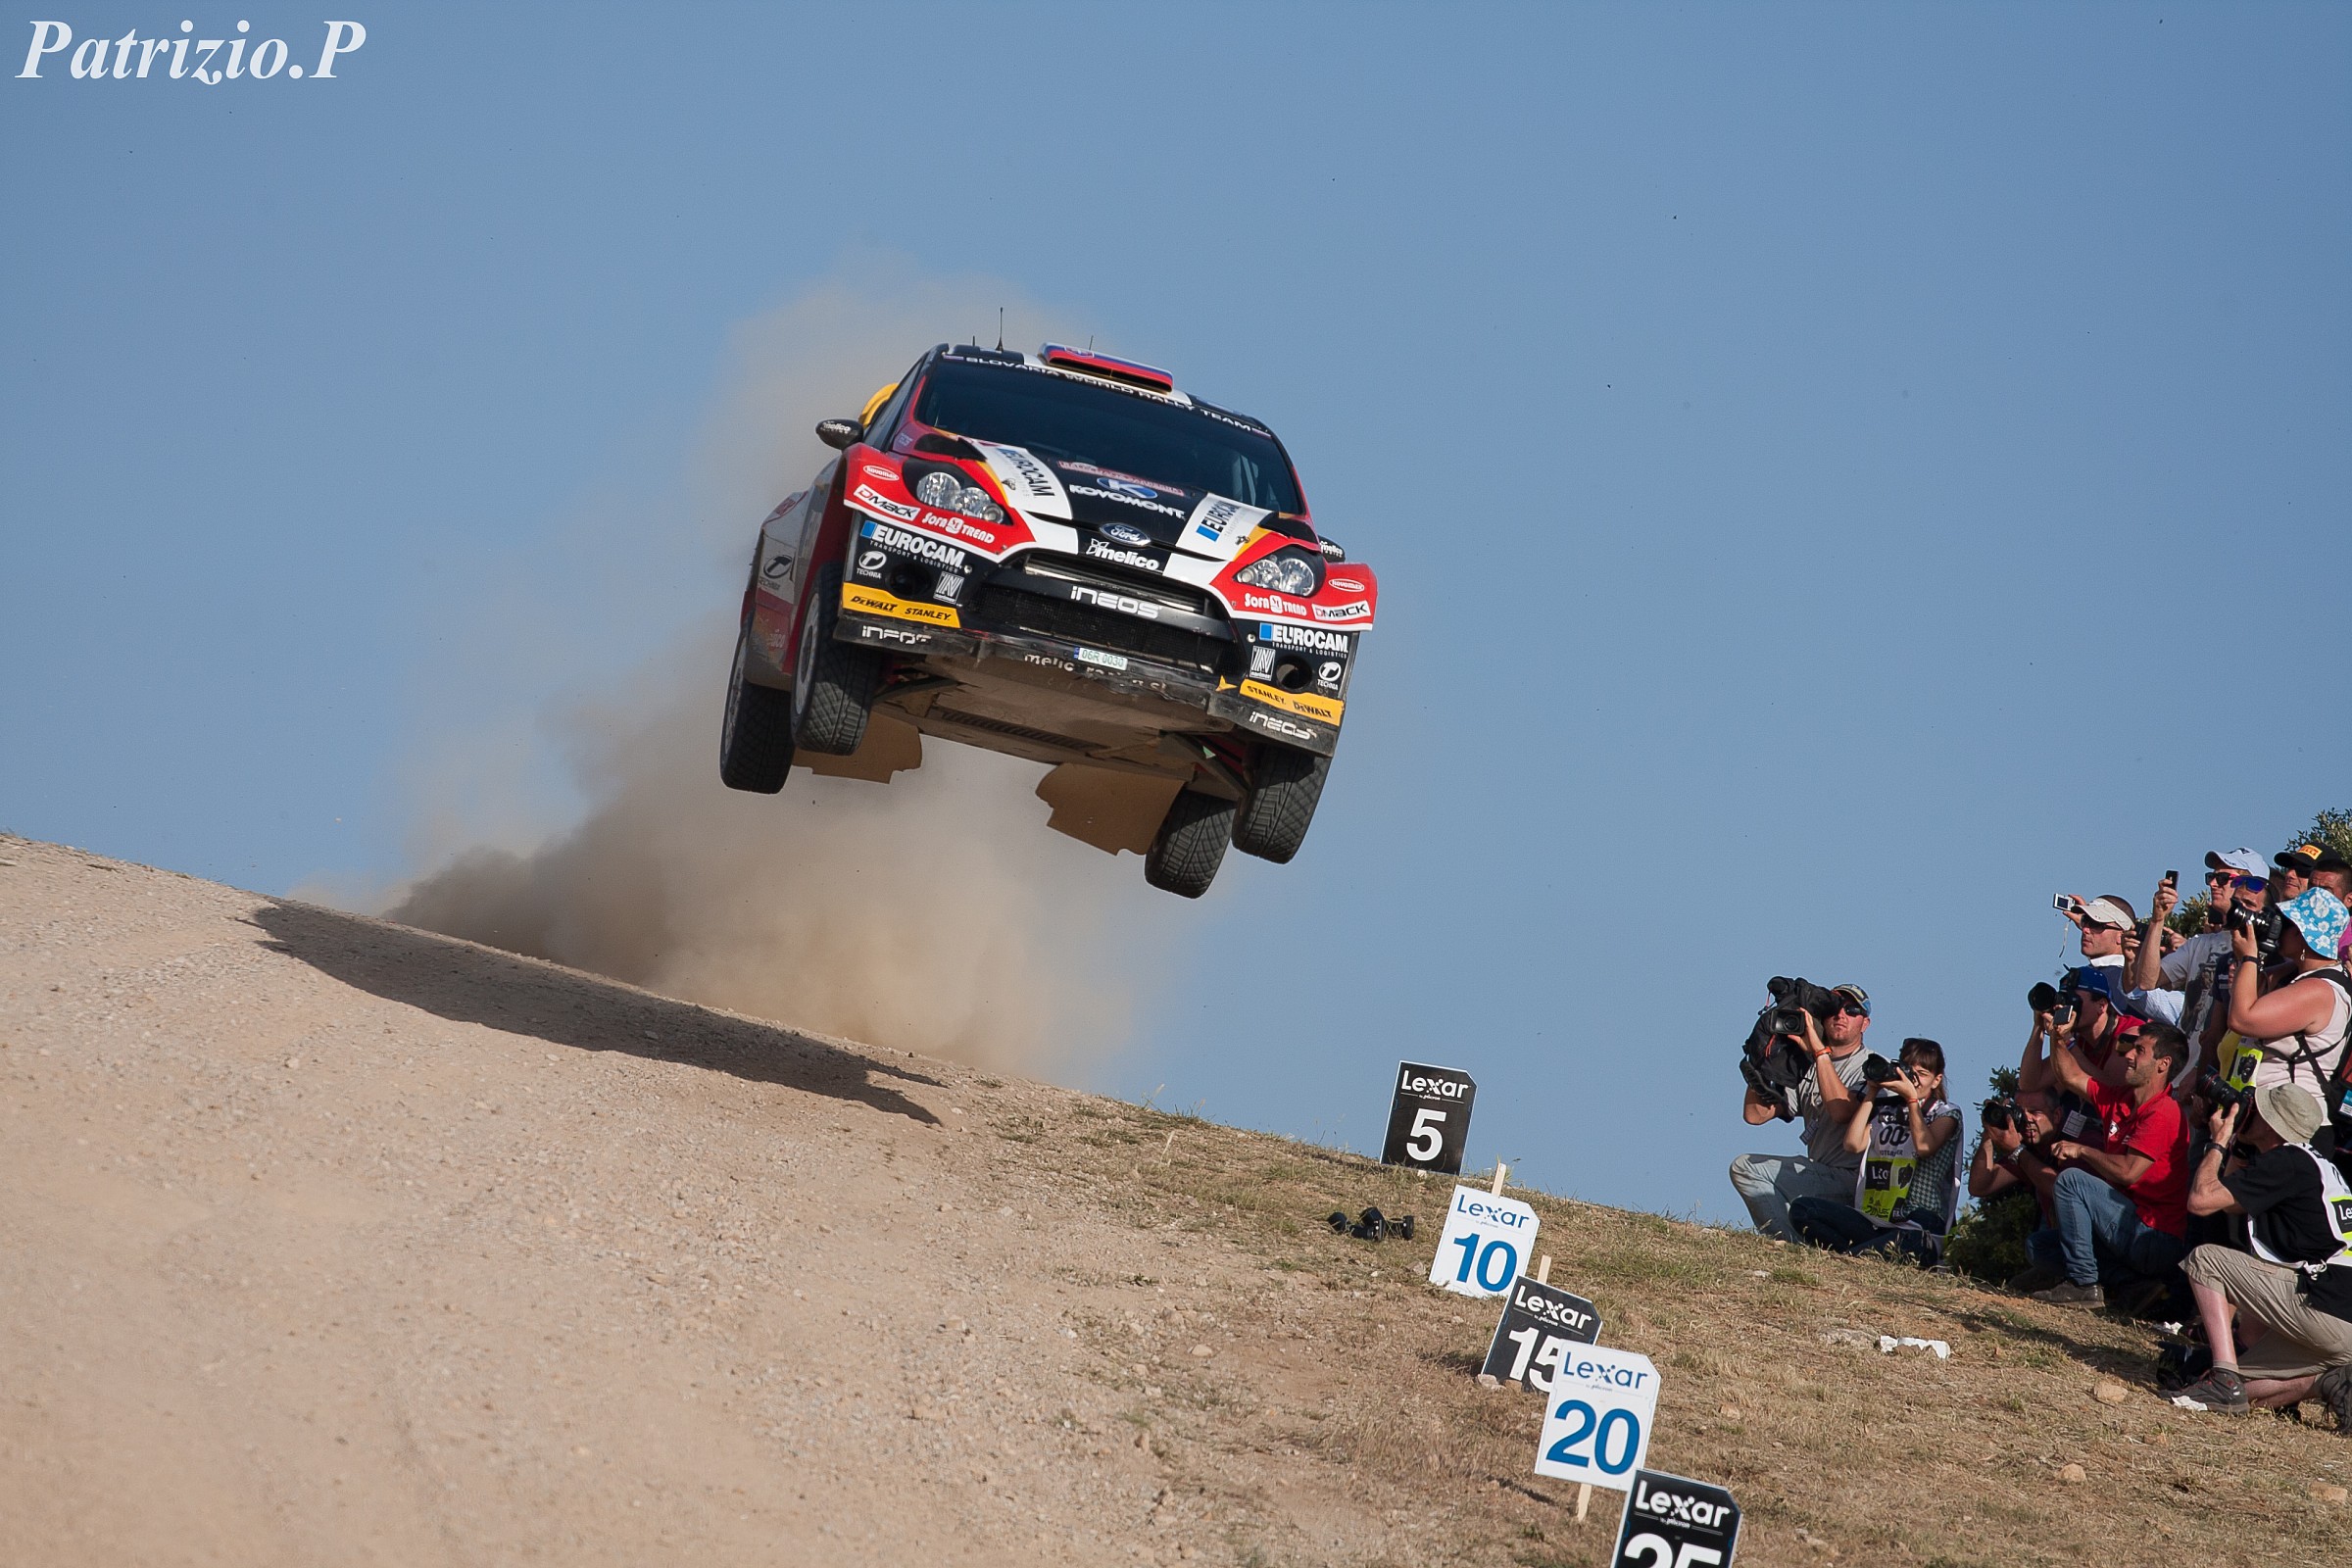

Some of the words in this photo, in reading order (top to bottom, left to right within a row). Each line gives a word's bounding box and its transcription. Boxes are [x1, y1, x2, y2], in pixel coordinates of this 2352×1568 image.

[1138, 391, 1196, 412] RALLY
[1200, 408, 1252, 432] TEAM
[1069, 484, 1185, 519] KOVOMONT
[869, 540, 910, 559] TRANSPORT
[871, 524, 965, 568] EUROCAM
[1110, 524, 1141, 542] Ford
[1095, 546, 1160, 570] melico
[905, 608, 952, 621] STANLEY
[1070, 585, 1159, 619] INEOS
[1272, 642, 1306, 653] TRANSPORT
[1275, 624, 1348, 654] EUROCAM
[1247, 685, 1286, 705] STANLEY
[1400, 1069, 1469, 1099] Lexar
[1405, 1107, 1447, 1161] 5
[1456, 1194, 1530, 1229] Lexar
[1452, 1232, 1518, 1293] 10
[1514, 1285, 1592, 1330] Lexar
[1508, 1326, 1561, 1393] 15
[1563, 1350, 1648, 1390] Lexar
[1544, 1398, 1641, 1476] 20
[1635, 1479, 1731, 1528] Lexar
